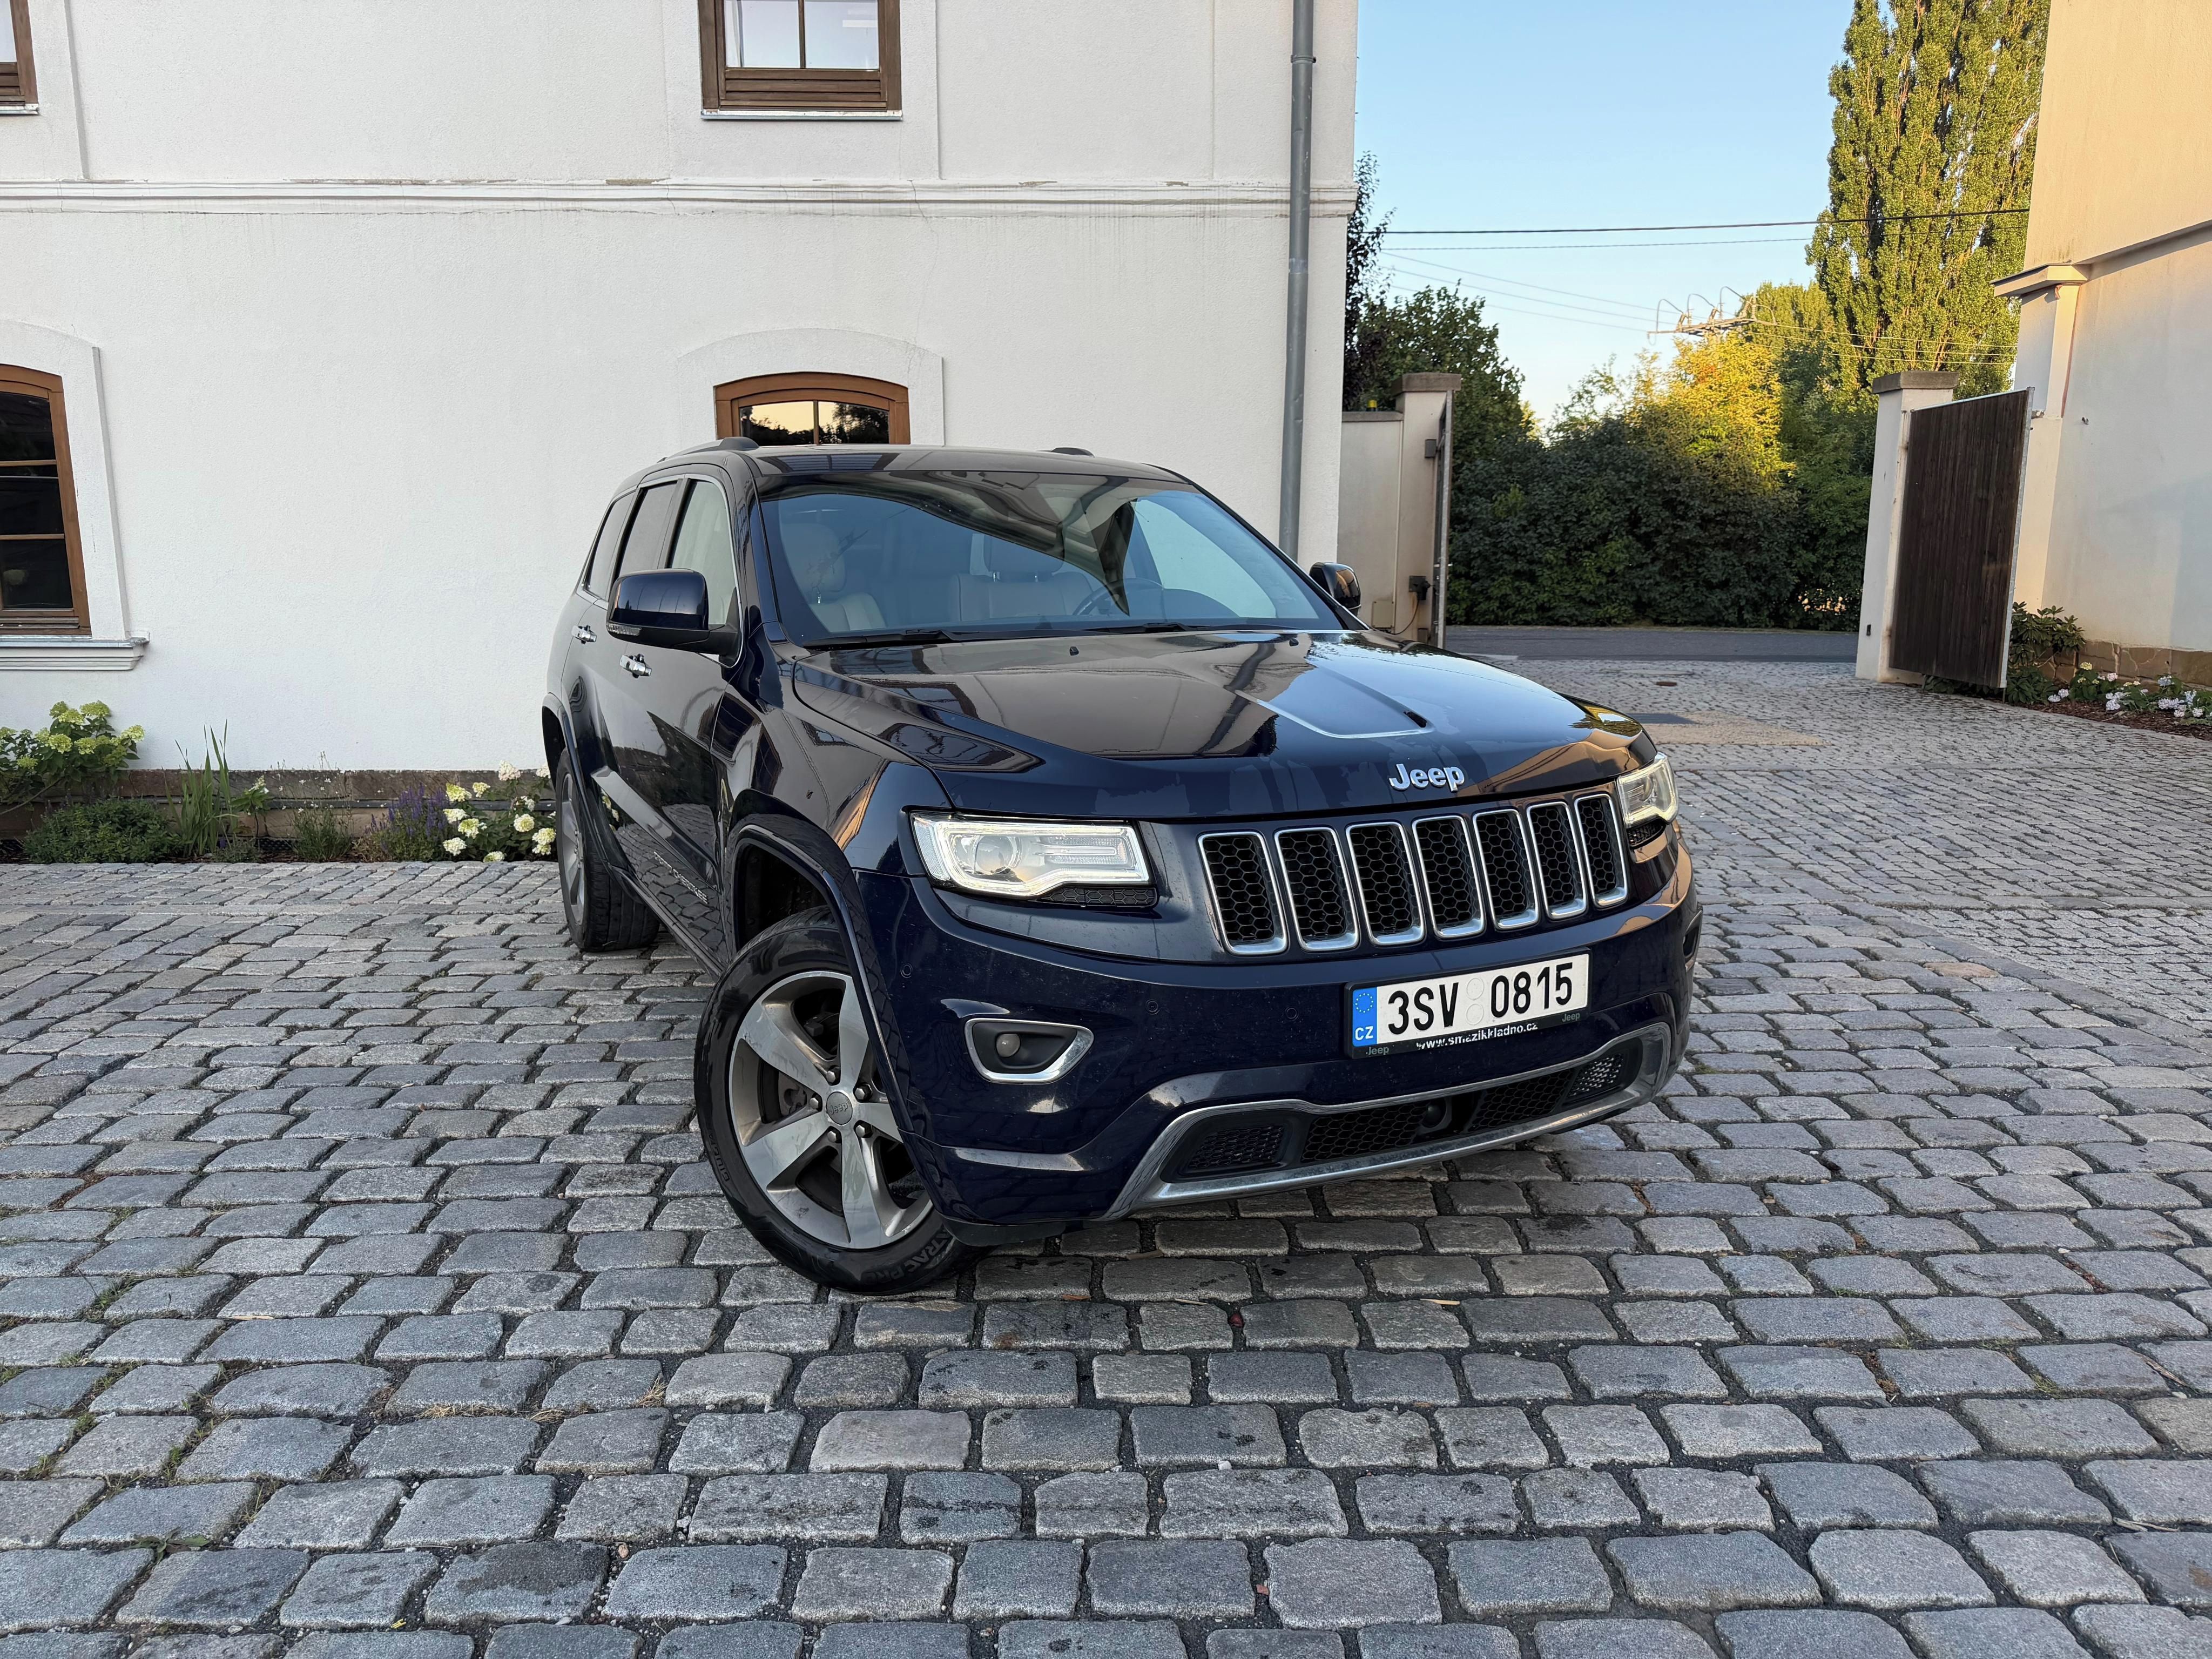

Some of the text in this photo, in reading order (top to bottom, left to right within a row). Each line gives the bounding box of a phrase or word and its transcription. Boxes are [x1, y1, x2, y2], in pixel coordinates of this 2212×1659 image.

[1388, 763, 1465, 792] Jeep
[1387, 962, 1573, 1035] 3SV 0815
[1562, 1013, 1580, 1022] Jeep
[1355, 1026, 1374, 1041] CZ
[1366, 1047, 1389, 1055] Jeep
[829, 1102, 848, 1115] Jeep
